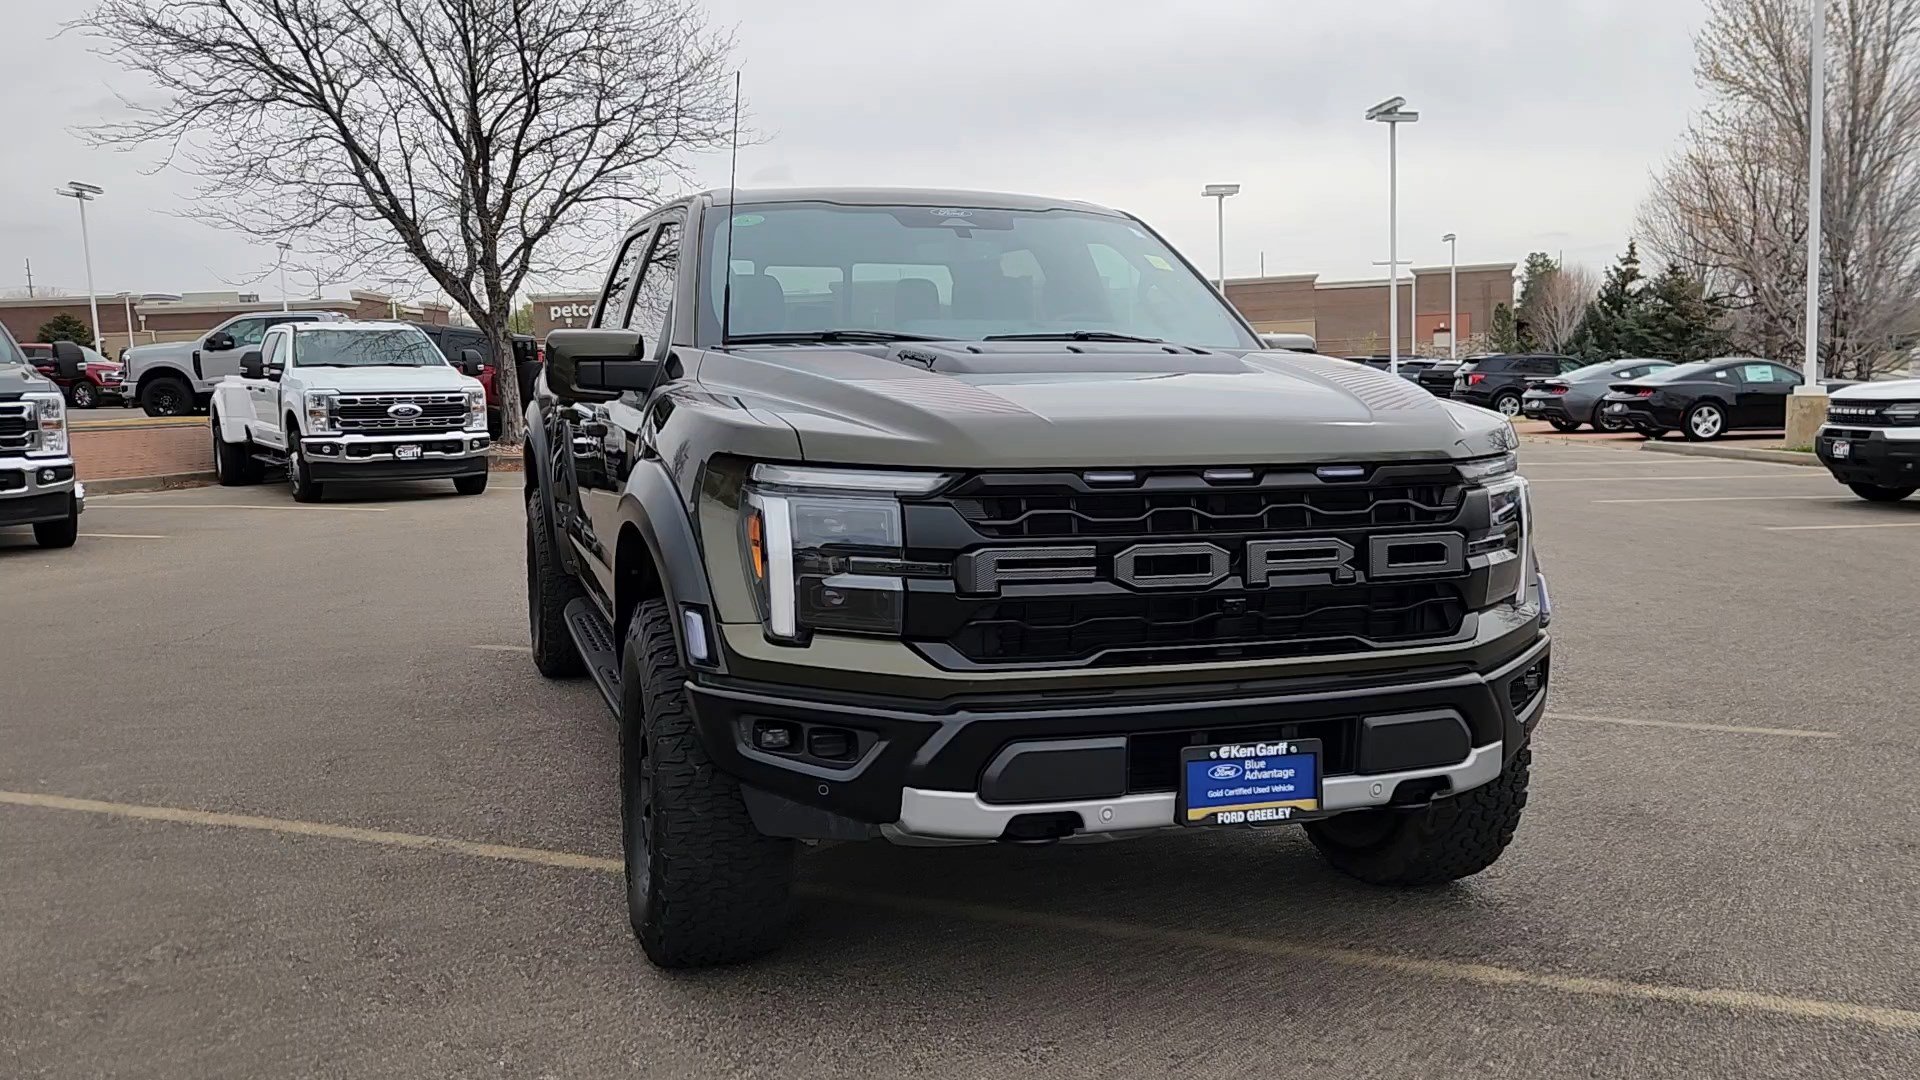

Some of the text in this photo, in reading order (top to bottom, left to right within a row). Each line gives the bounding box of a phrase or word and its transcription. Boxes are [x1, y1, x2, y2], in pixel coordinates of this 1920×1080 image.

[959, 530, 1465, 594] FORD
[1230, 742, 1288, 758] Ken Garff
[1244, 759, 1266, 769] Blue
[1244, 768, 1295, 781] Advantage
[1207, 784, 1295, 798] Gold Certified Used Vehicle
[1217, 807, 1292, 824] FORD GREELEY
